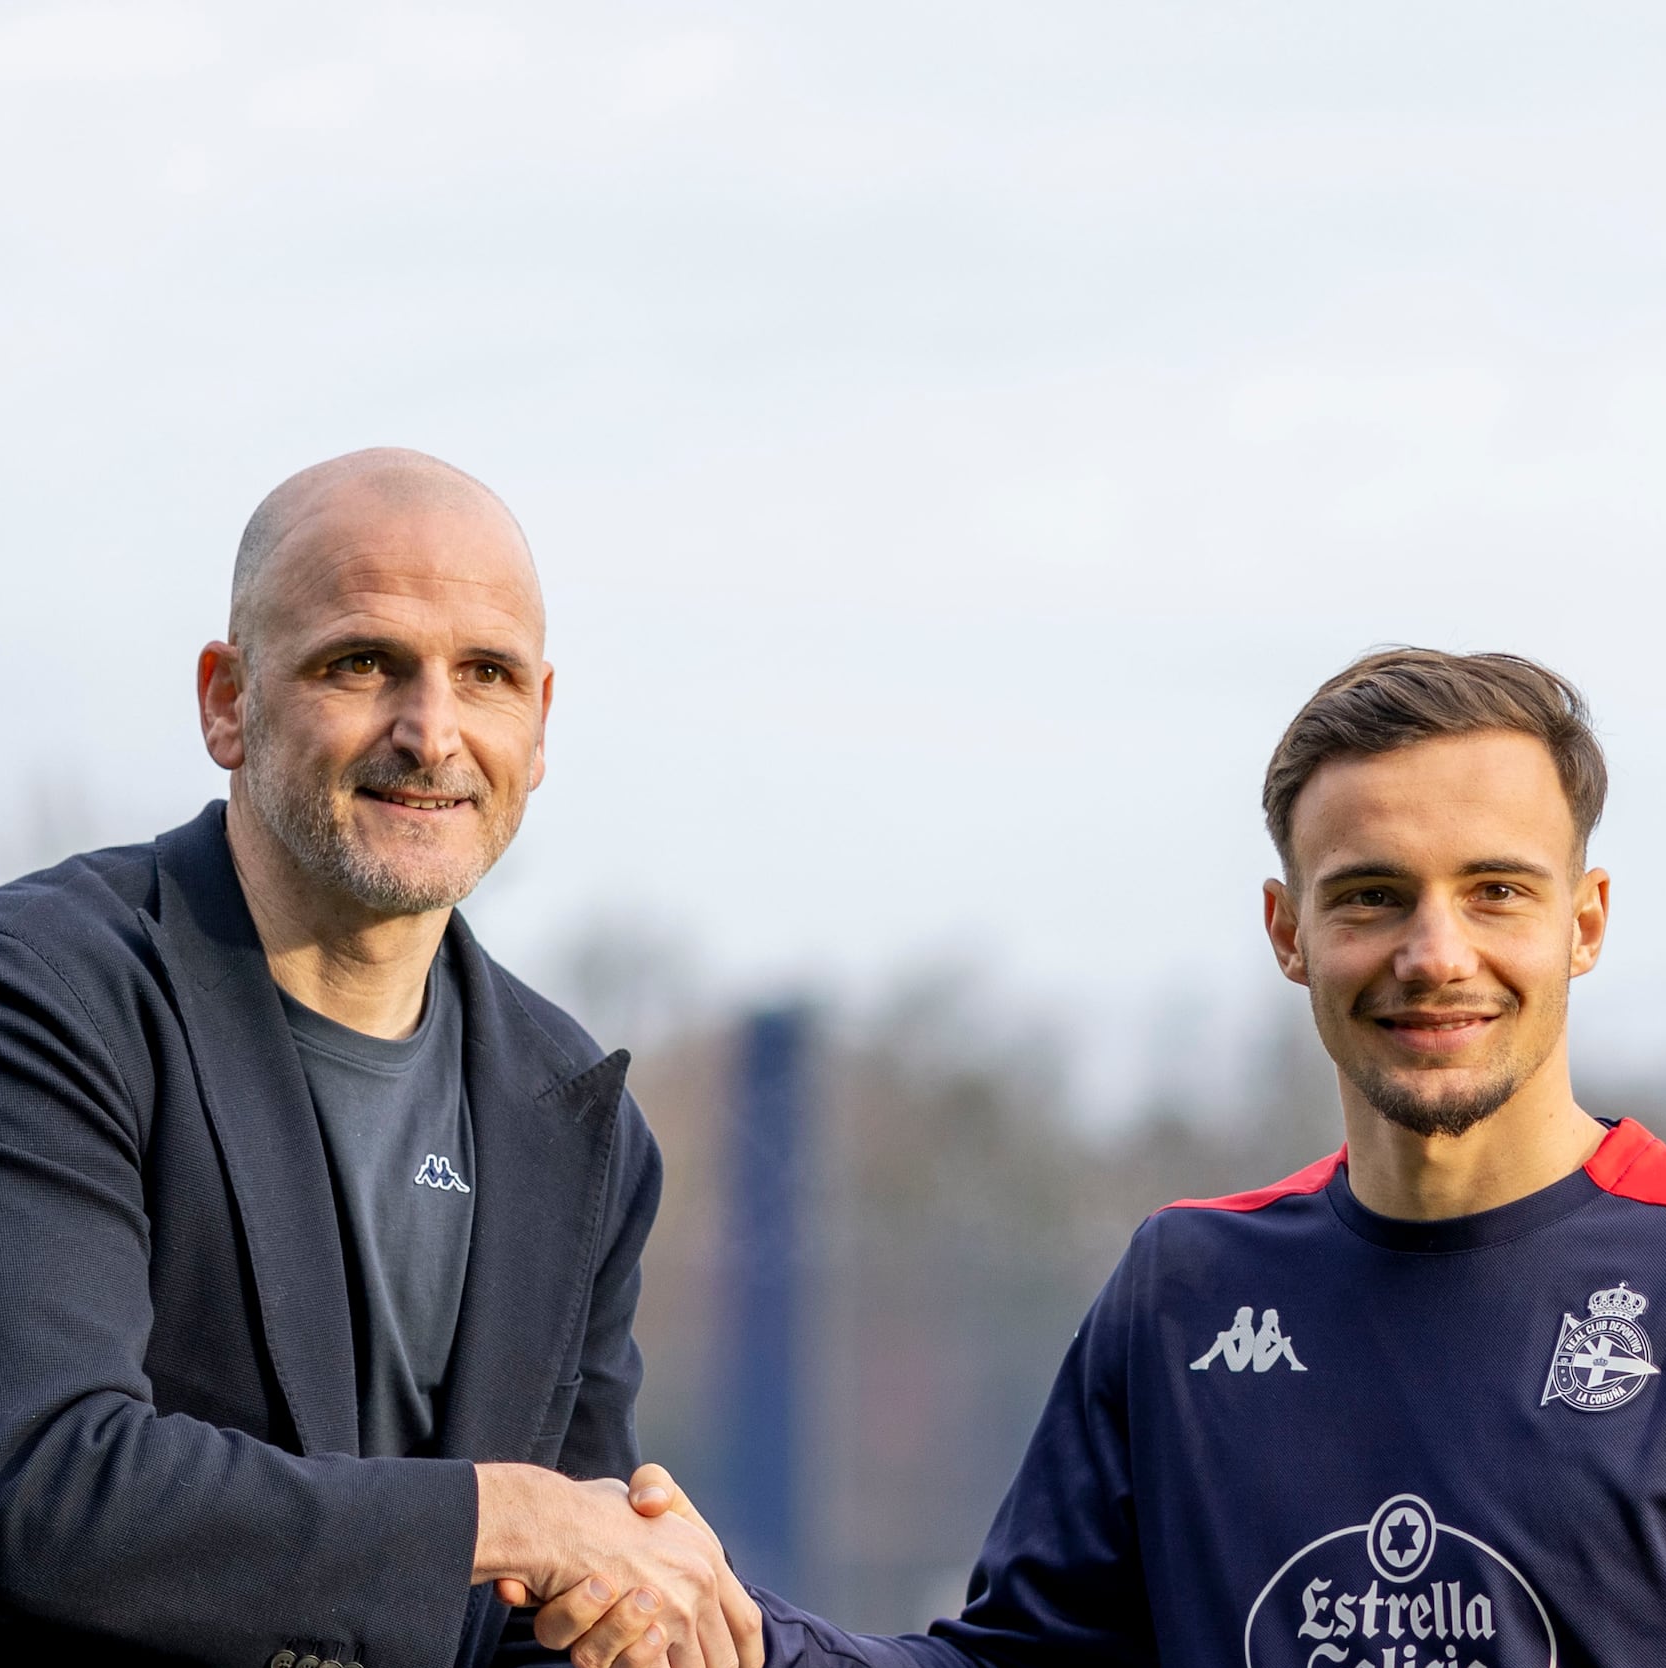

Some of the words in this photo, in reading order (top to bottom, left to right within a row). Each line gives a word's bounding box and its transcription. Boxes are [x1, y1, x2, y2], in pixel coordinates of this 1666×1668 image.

[1565, 1330, 1587, 1352] REAL
[1585, 1320, 1608, 1335] CLUB
[1608, 1320, 1643, 1354] DEPORTIVO
[1576, 1390, 1588, 1404] LA
[1297, 1576, 1497, 1641] Estrella
